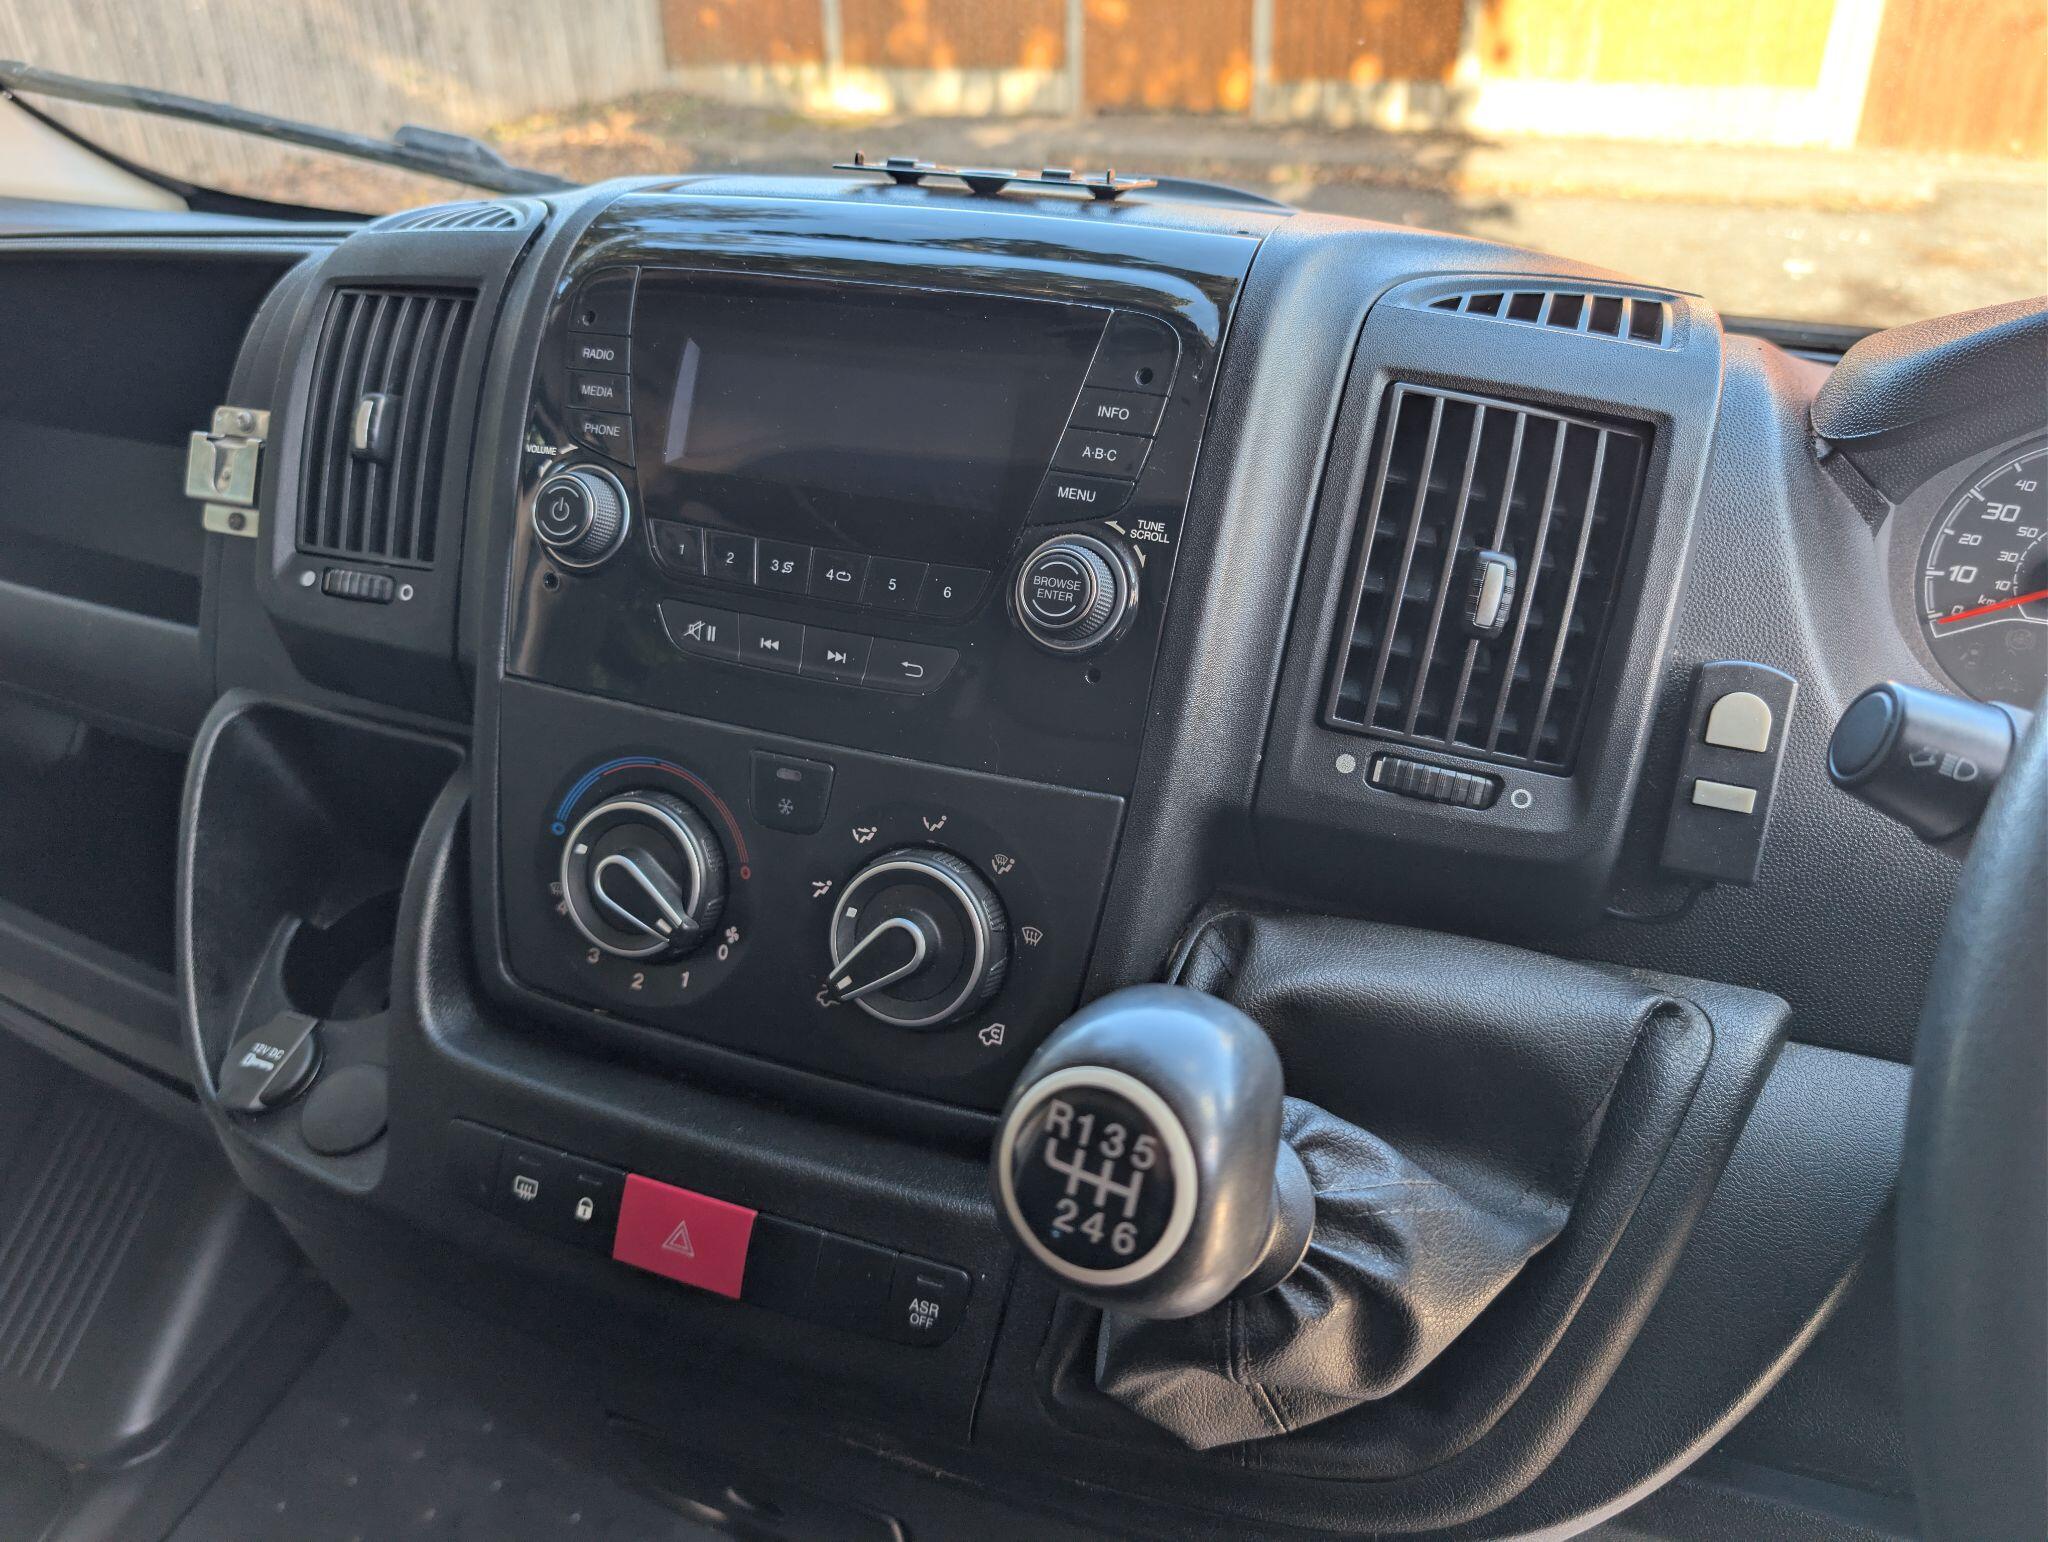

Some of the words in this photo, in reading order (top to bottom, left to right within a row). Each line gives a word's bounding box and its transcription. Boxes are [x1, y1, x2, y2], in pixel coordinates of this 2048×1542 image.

[583, 347, 614, 361] RADIO
[581, 384, 613, 398] MEDIA
[1097, 405, 1130, 420] INFO
[584, 422, 620, 437] PHONE
[526, 443, 557, 456] VOLUME
[2015, 479, 2037, 492] 40
[1057, 486, 1096, 502] MENU
[1981, 502, 2021, 522] 30
[1137, 519, 1165, 532] TUNE
[2016, 526, 2039, 537] 50
[1130, 529, 1170, 544] SCROLL
[1958, 533, 1982, 546] 20
[1997, 551, 2018, 562] 30
[679, 544, 686, 555] 1
[726, 552, 735, 564] 2
[771, 560, 780, 572] 3
[825, 568, 835, 581] 4
[888, 579, 897, 591] 5
[943, 586, 952, 599] 6
[1949, 565, 1978, 583] 10
[1033, 575, 1082, 592] BROWSE
[1995, 580, 2011, 591] 10
[1036, 588, 1073, 603] ENTER
[587, 948, 600, 963] 3
[717, 944, 729, 961] 0
[630, 972, 645, 991] 2
[680, 970, 690, 989] 1
[909, 1298, 940, 1318] ASR
[910, 1313, 934, 1328] OFF
